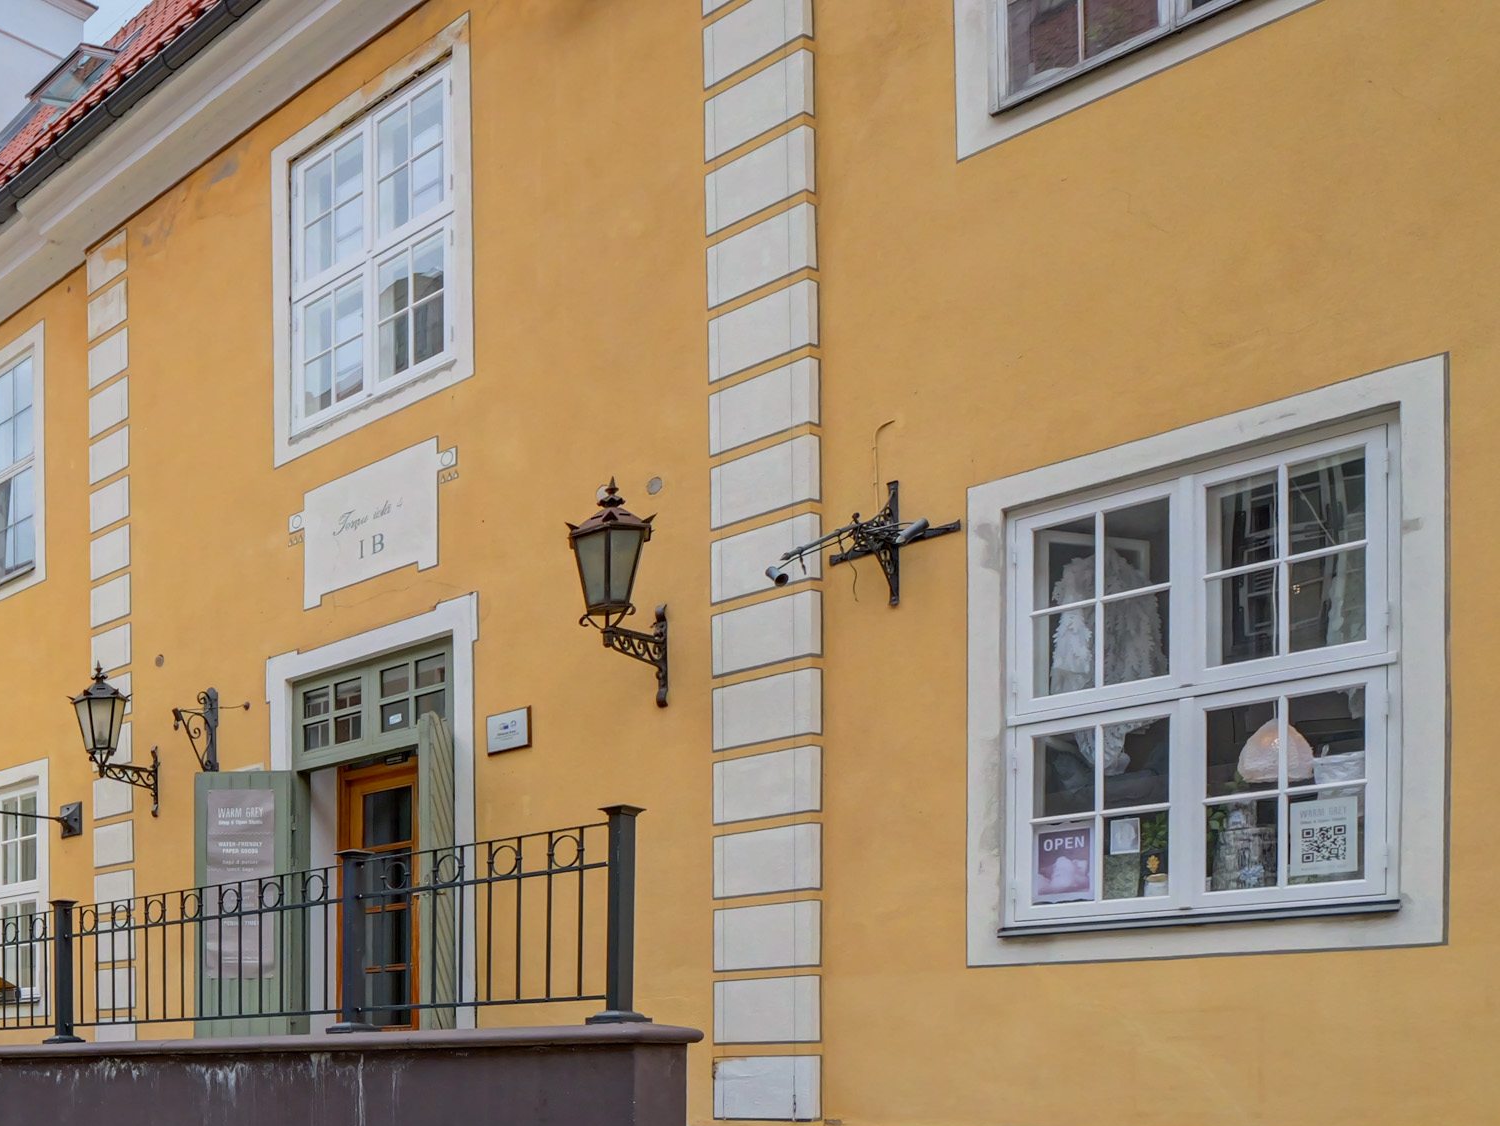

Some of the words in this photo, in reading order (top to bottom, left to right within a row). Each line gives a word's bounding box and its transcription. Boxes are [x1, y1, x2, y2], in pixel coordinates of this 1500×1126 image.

[217, 807, 242, 818] WARM
[245, 806, 264, 818] GREY
[1300, 808, 1325, 819] WARM
[1043, 835, 1085, 852] OPEN
